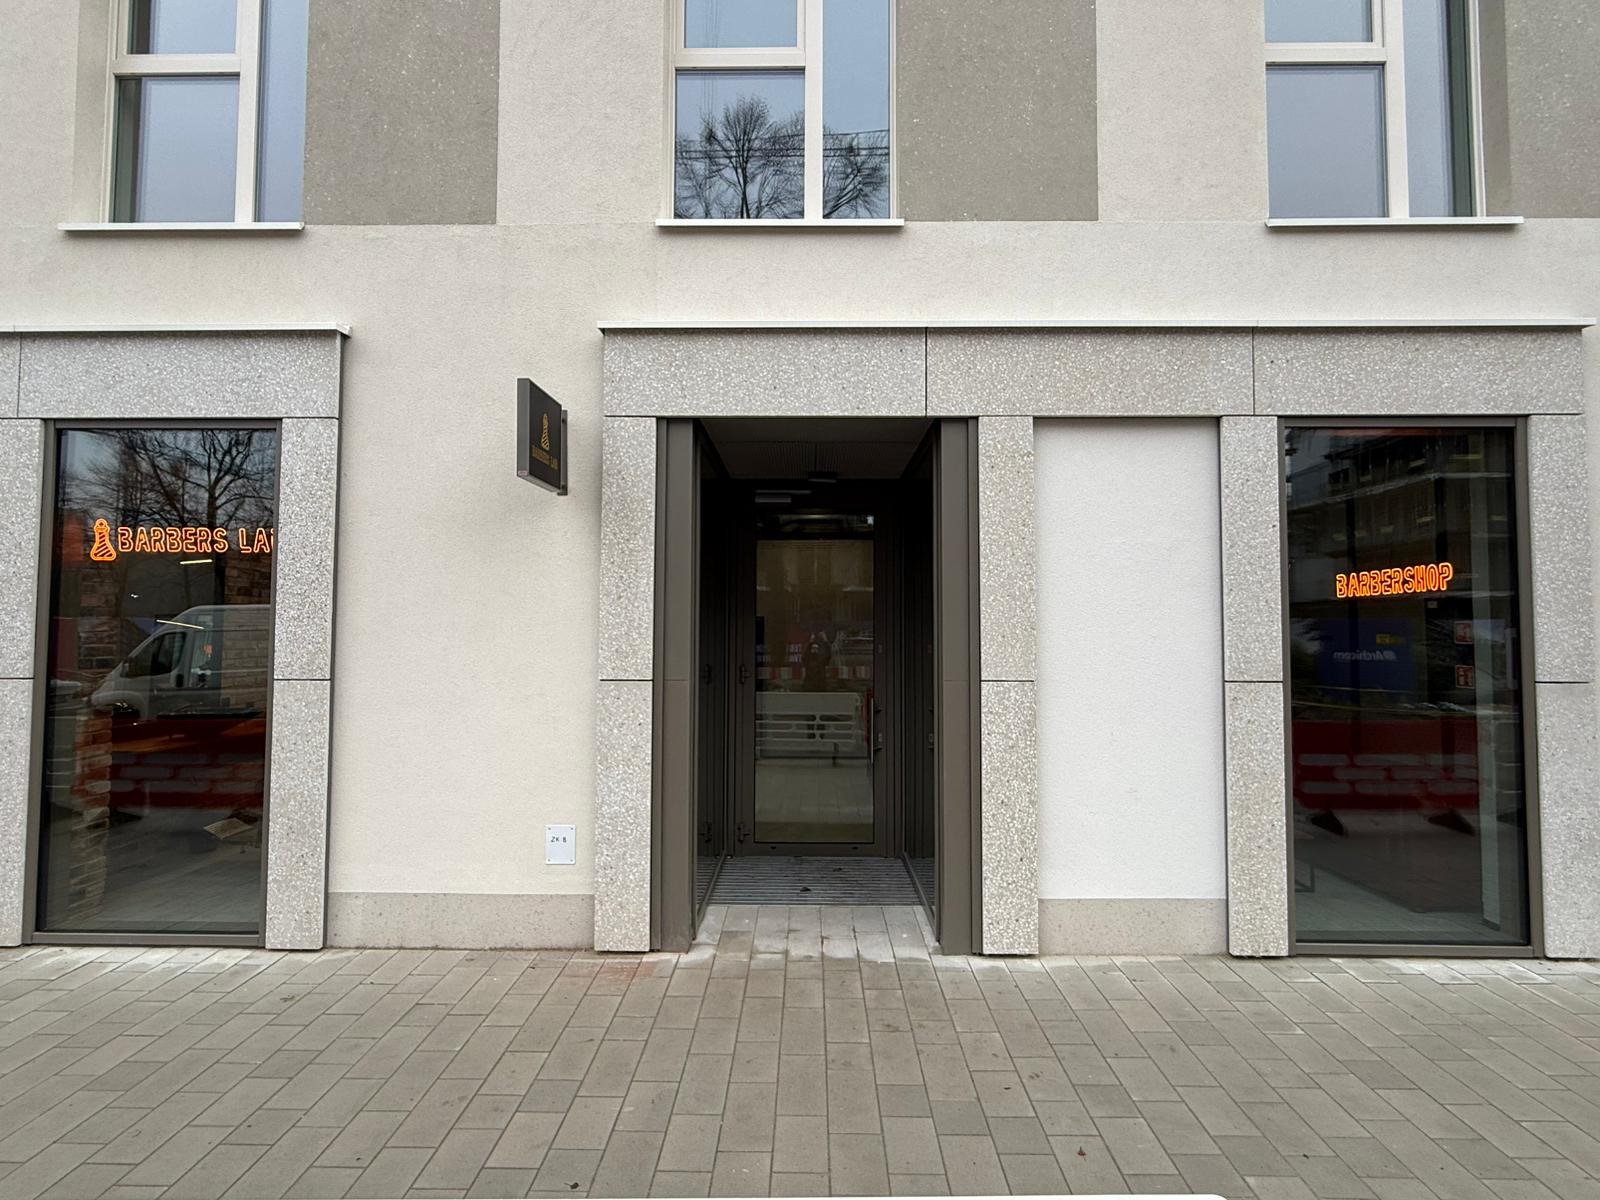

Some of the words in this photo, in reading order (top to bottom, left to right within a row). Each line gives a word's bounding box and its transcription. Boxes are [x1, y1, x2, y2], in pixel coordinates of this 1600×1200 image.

[117, 526, 229, 553] BARBERS
[239, 527, 274, 553] LA
[1336, 562, 1453, 598] BARBERSHOP
